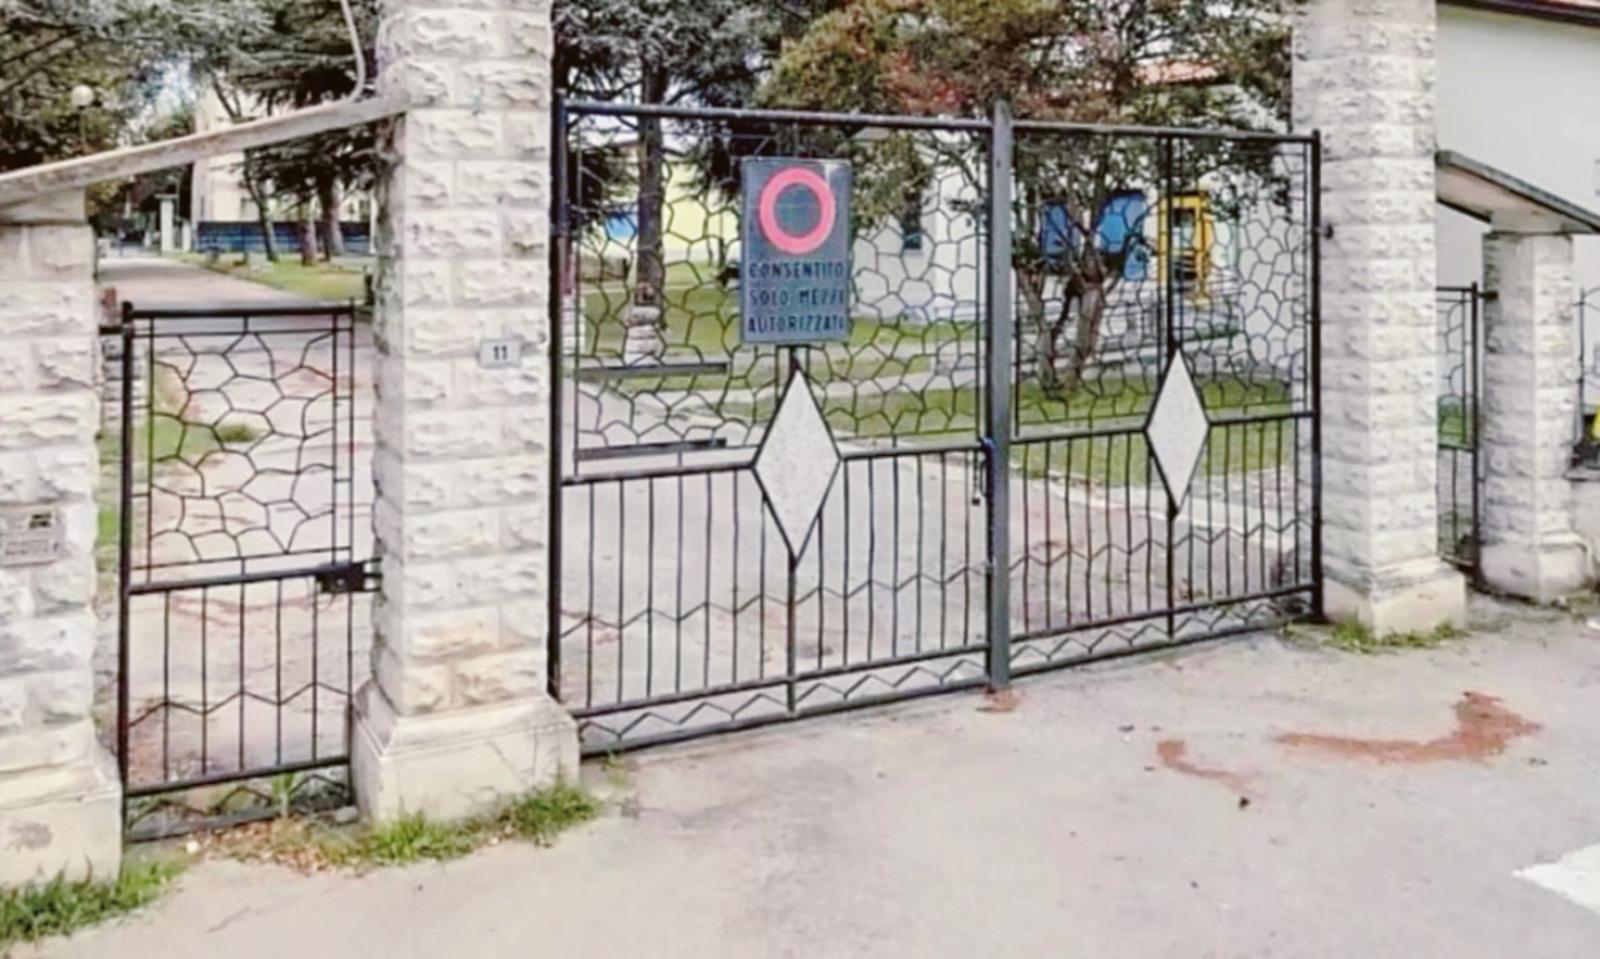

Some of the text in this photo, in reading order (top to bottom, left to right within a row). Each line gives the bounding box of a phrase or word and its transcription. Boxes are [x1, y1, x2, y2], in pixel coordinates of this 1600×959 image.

[749, 261, 844, 279] CONSENTITO
[750, 288, 844, 306] SOLO MEZZI
[493, 344, 508, 361] 11
